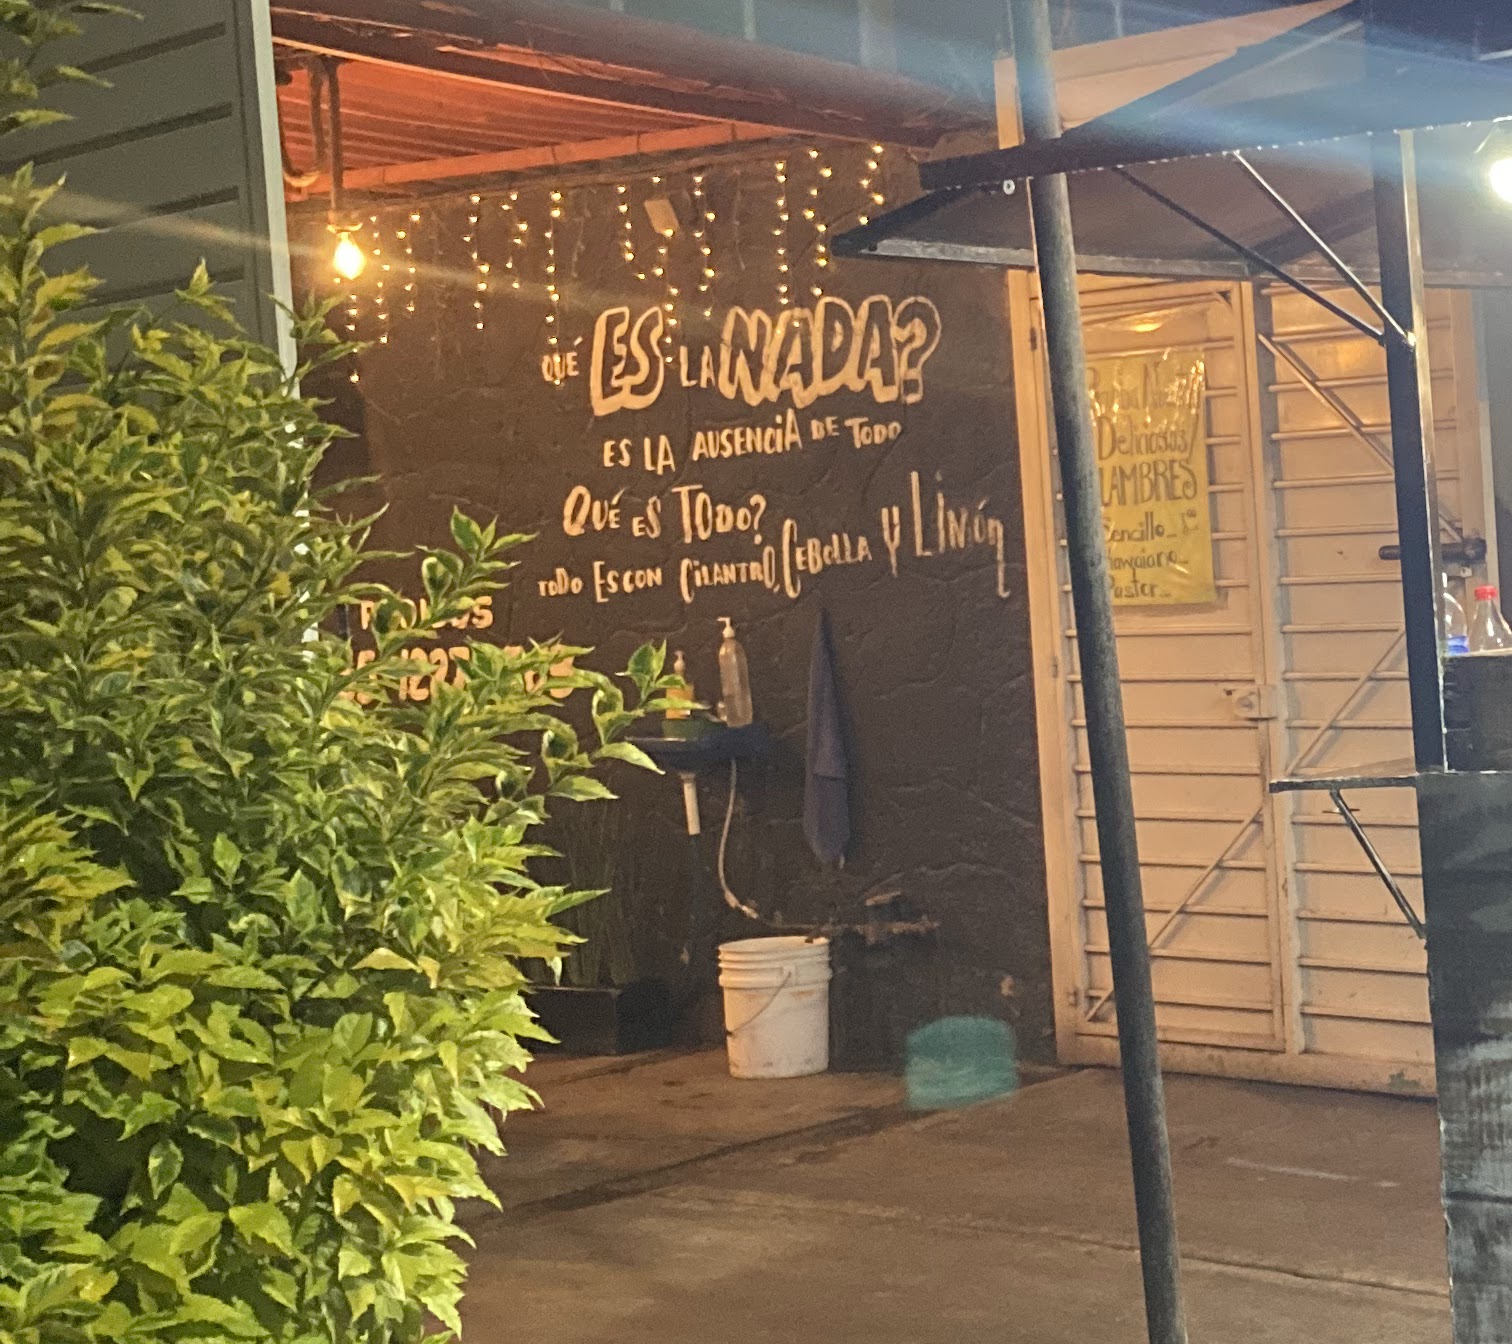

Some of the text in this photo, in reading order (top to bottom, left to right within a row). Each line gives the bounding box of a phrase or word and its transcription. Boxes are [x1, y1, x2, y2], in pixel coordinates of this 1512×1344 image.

[542, 294, 942, 416] QUÉ ES LA NADA?
[603, 438, 632, 468] ES
[643, 434, 676, 476] LA
[811, 416, 839, 441] DE
[845, 416, 902, 449] TODO
[538, 567, 583, 597] TODO
[782, 518, 873, 598] CEBOLLA
[881, 506, 900, 578] Y
[632, 496, 661, 539] ES
[672, 484, 767, 545] TODO?
